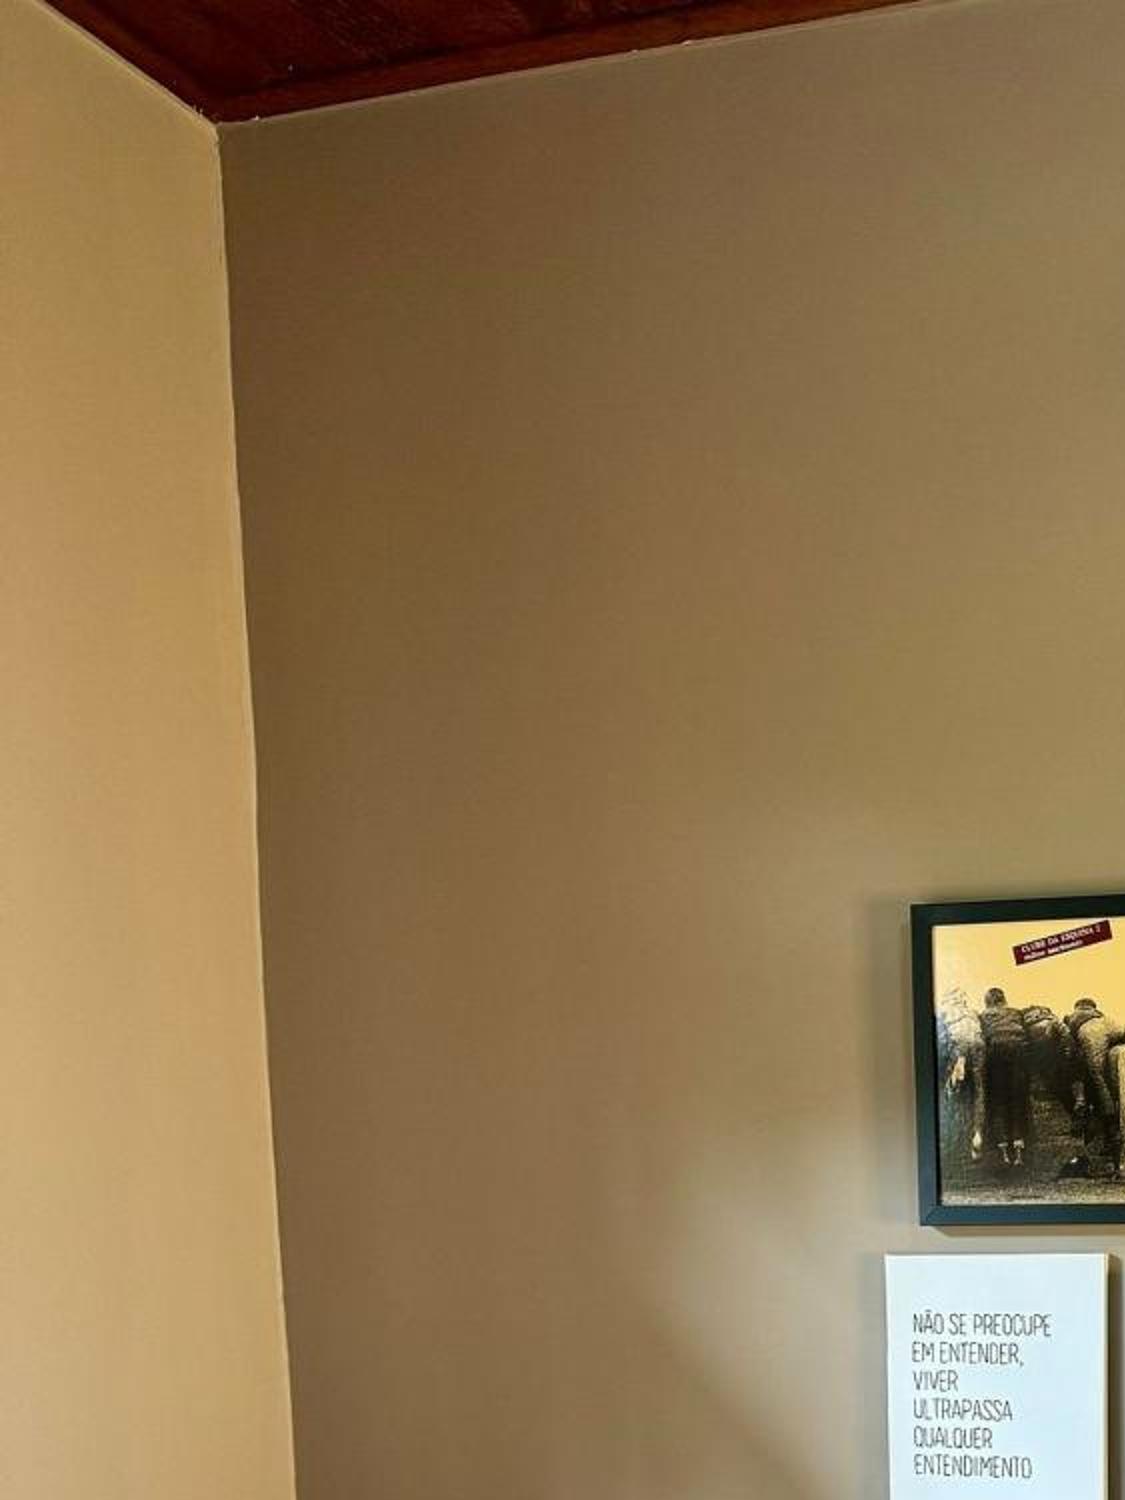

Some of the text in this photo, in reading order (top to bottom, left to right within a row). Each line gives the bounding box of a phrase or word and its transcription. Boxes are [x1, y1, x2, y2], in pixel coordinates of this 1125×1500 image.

[912, 1310, 1052, 1338] NÃO SE PREOCUPE
[911, 1341, 1025, 1368] EM ENTENDER,
[912, 1370, 959, 1393] VIVER
[913, 1397, 1014, 1422] ULTRAPASSA
[913, 1425, 993, 1450] QUALQUER
[913, 1453, 1033, 1480] ENTENDIMENTO
